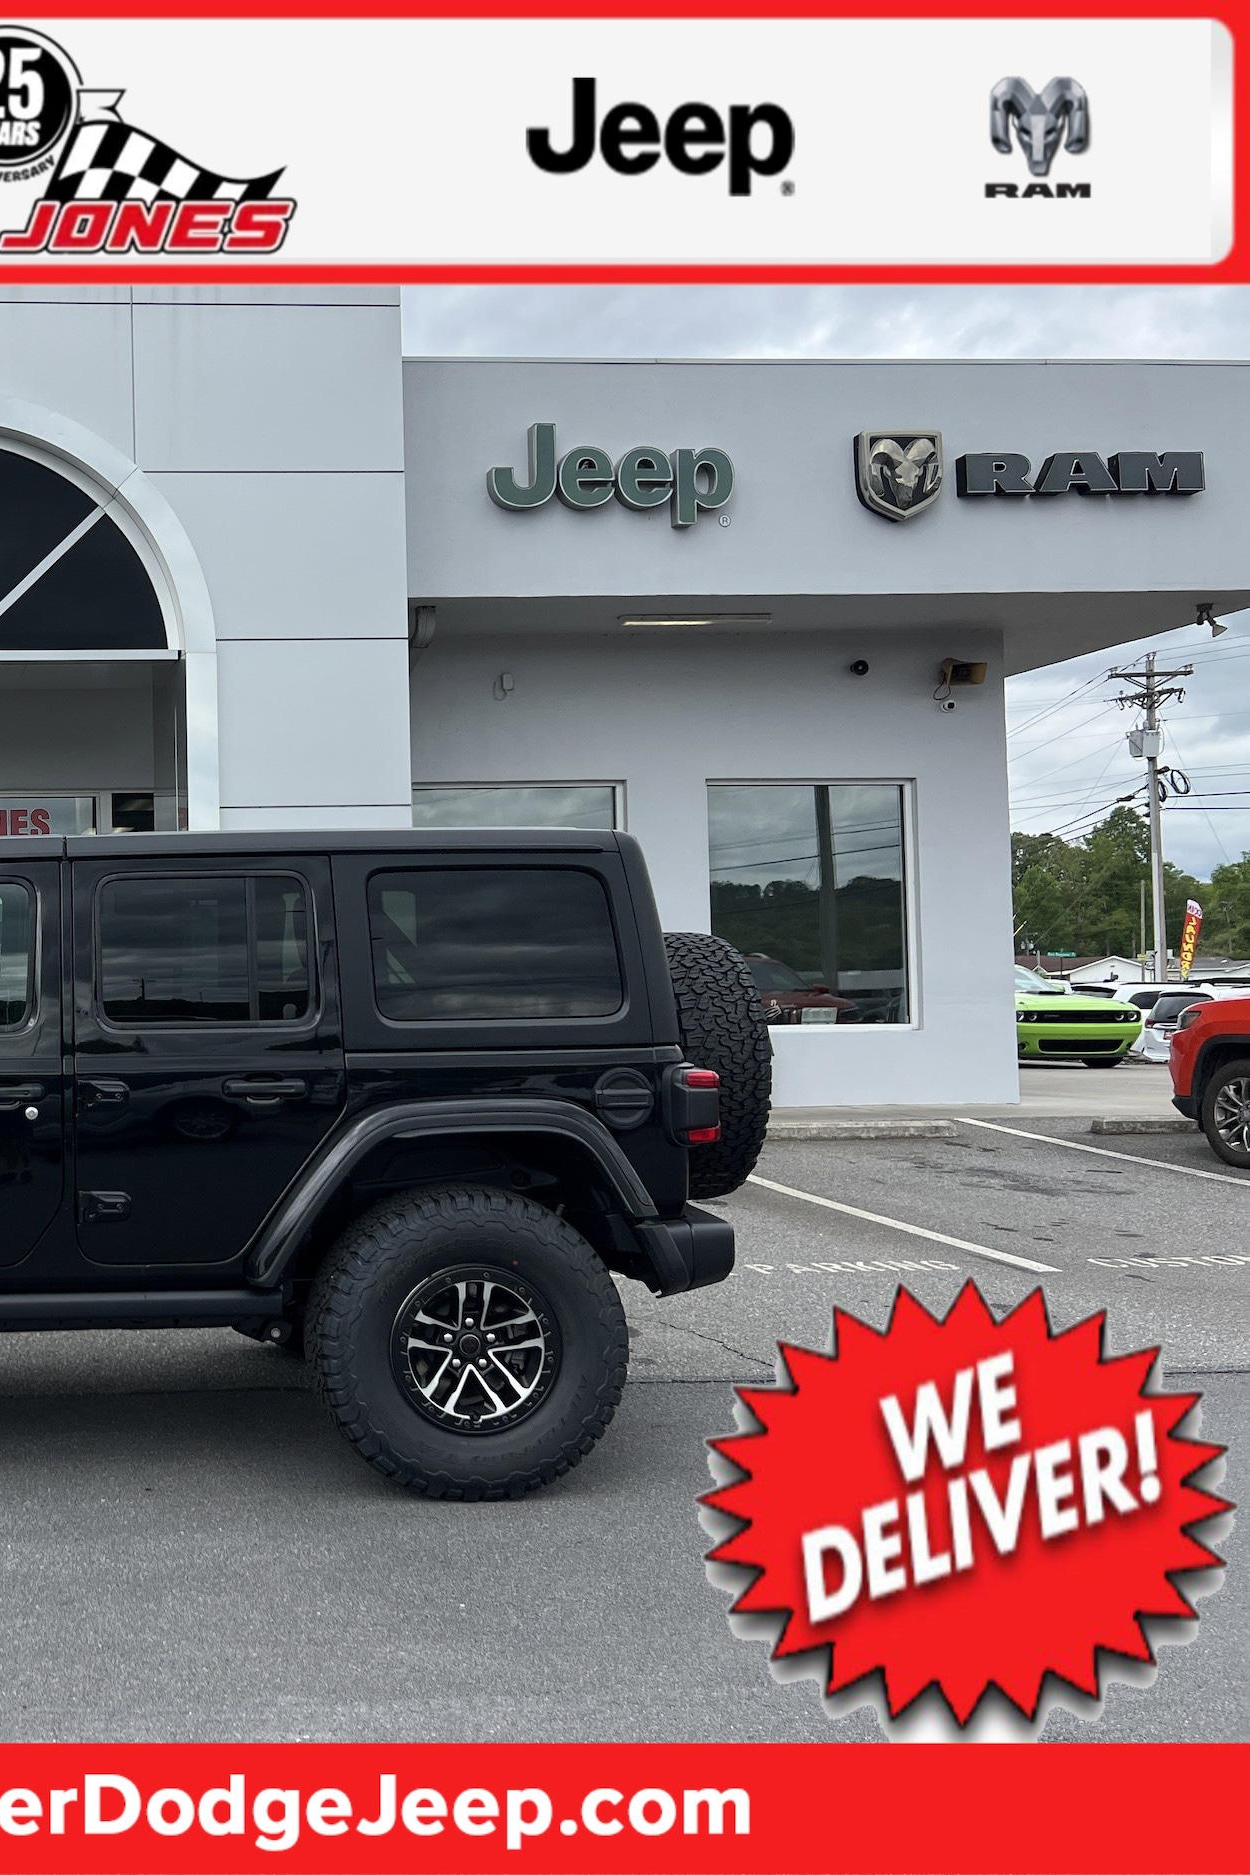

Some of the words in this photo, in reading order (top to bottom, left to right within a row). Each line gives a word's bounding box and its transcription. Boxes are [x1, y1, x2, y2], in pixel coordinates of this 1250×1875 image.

[486, 423, 736, 529] Jeep
[955, 451, 1206, 498] RAM
[744, 1259, 960, 1275] PARKING
